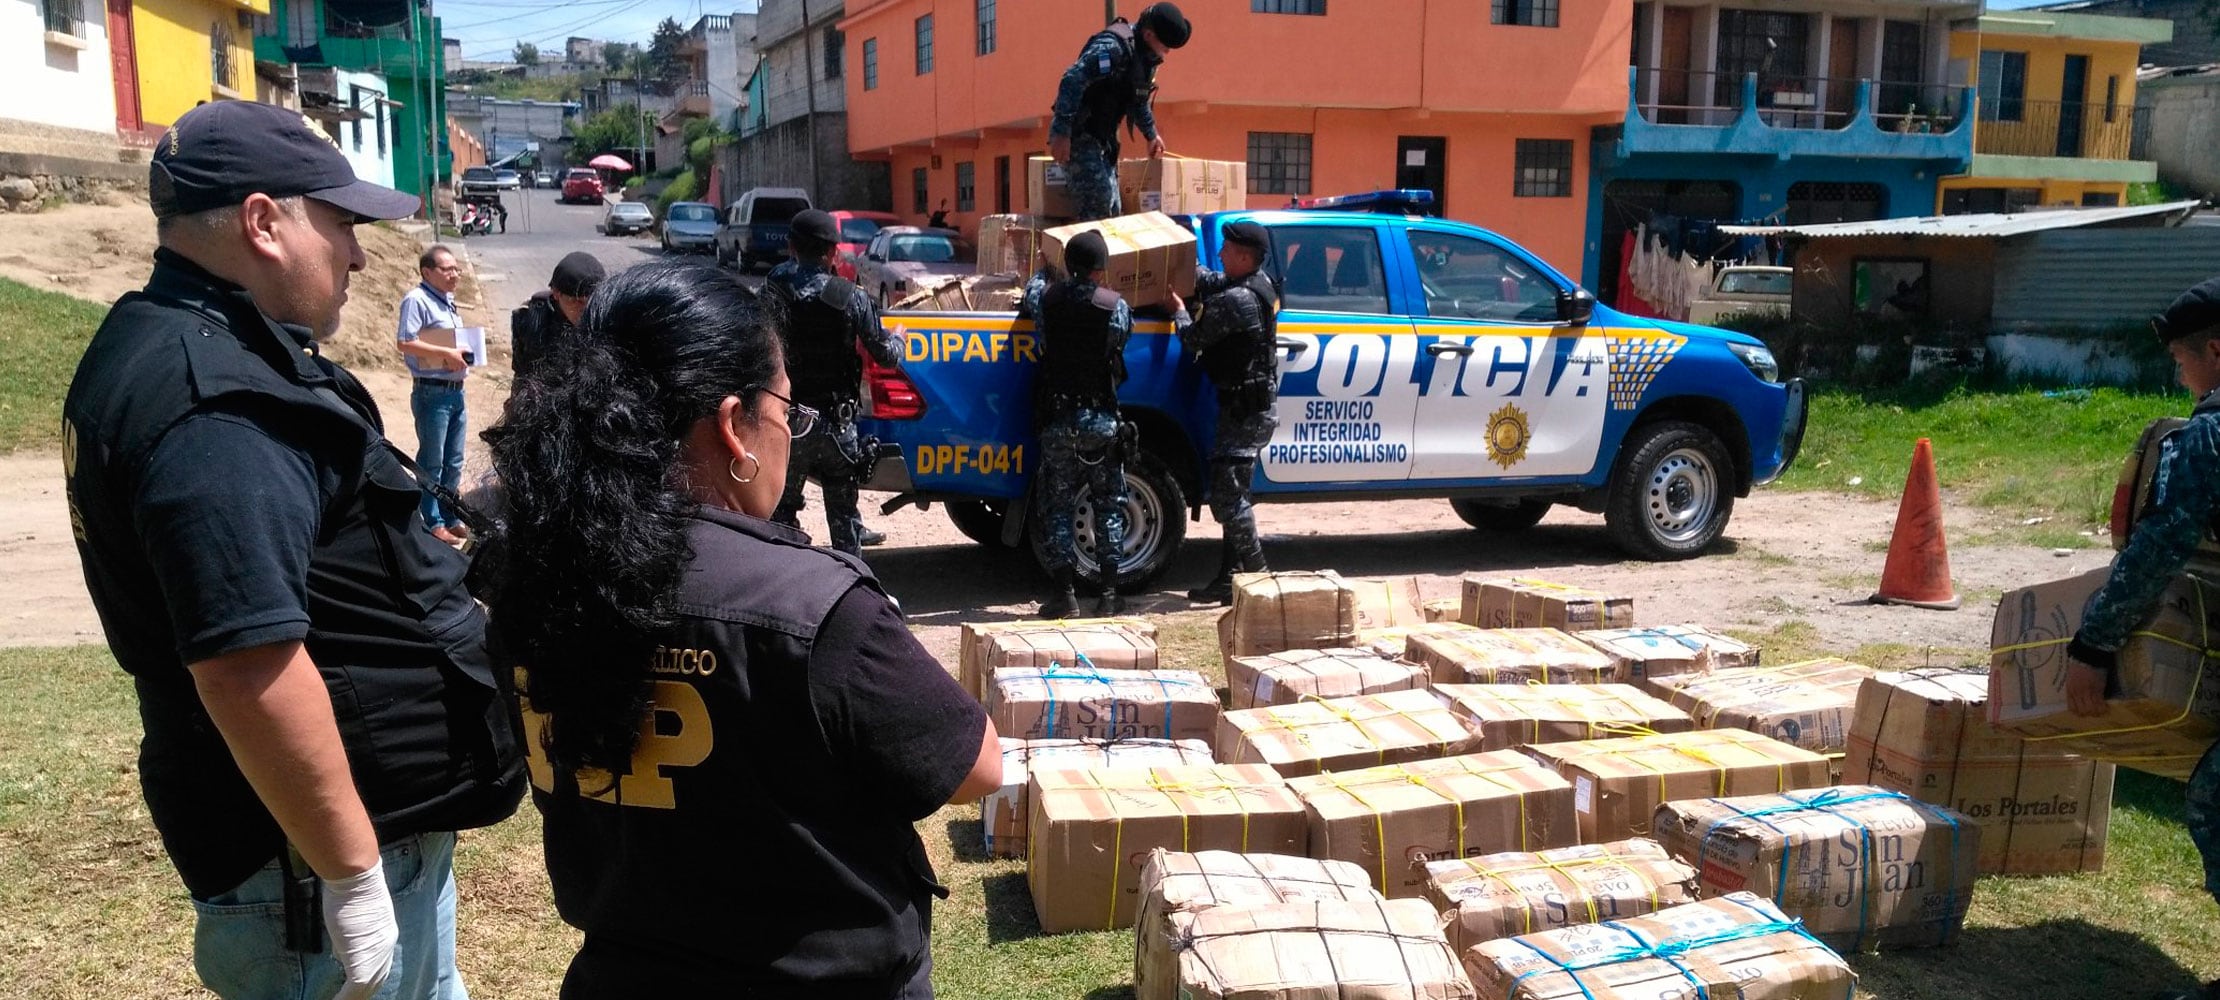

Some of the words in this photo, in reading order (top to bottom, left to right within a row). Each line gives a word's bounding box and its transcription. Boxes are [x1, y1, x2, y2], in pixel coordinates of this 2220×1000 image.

[905, 332, 1039, 363] DIPAFR
[1305, 400, 1374, 420] SERVICIO
[1293, 422, 1382, 442] INTEGRIDAD
[916, 444, 1024, 475] DPF-041
[1269, 444, 1408, 464] PROFESIONALISMO
[1957, 798, 1992, 818] Los
[1998, 794, 2079, 818] Portales
[1838, 827, 1905, 868] Sn
[1834, 861, 1925, 908] Jan
